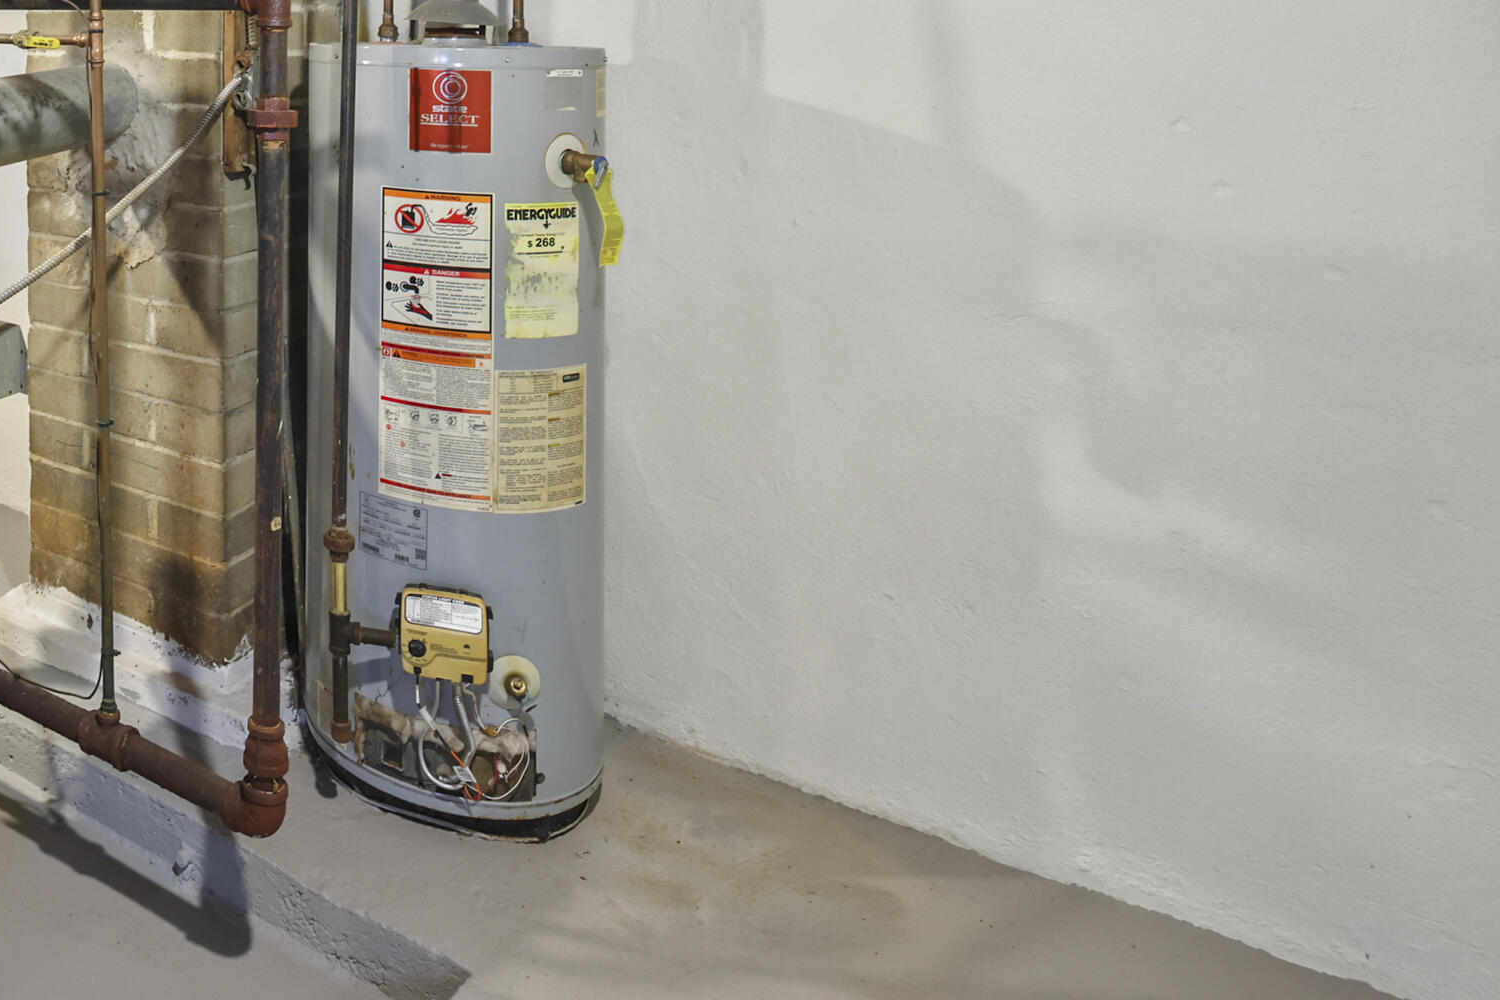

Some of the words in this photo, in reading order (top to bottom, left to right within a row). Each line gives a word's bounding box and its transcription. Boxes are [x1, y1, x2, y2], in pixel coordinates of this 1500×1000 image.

[432, 104, 468, 113] state
[420, 113, 480, 124] SELECT
[506, 207, 577, 221] ENERGYGUIDE
[535, 237, 556, 248] 268
[431, 268, 460, 277] DANGER
